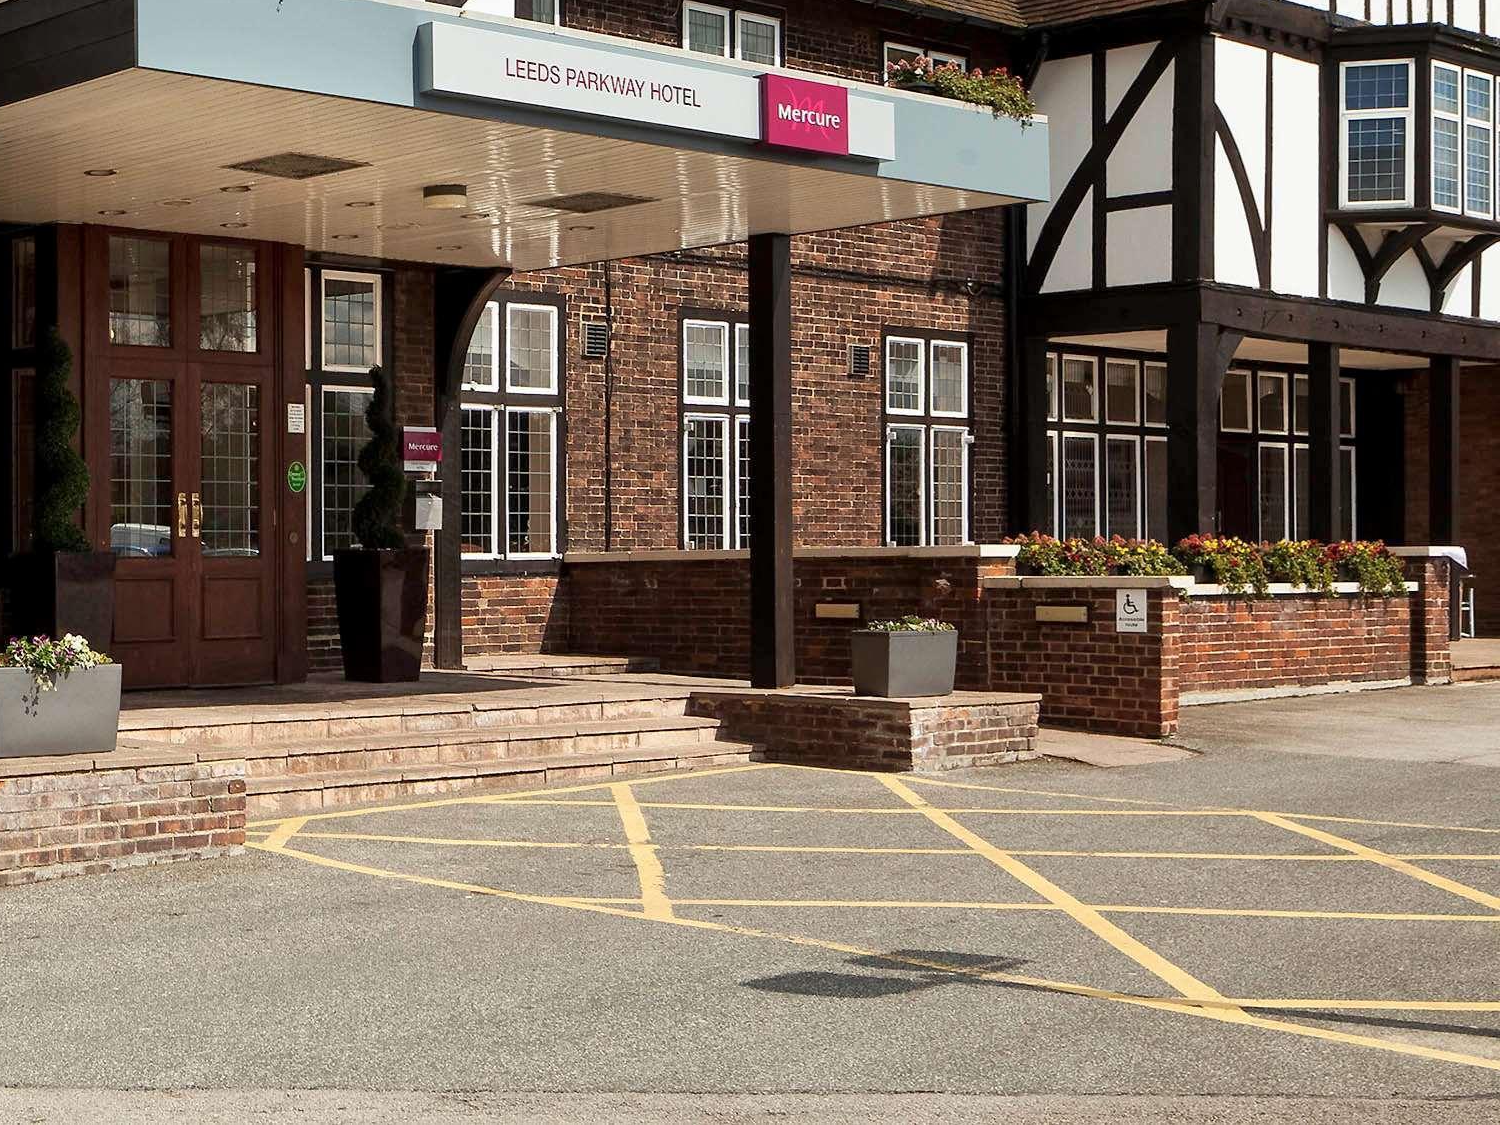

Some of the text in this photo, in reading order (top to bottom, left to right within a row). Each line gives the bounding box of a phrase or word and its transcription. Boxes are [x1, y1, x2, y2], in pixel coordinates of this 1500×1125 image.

[505, 57, 701, 108] LEEDS PARKWAY HOTEL
[778, 102, 841, 129] Mercure
[408, 442, 438, 451] Mercure
